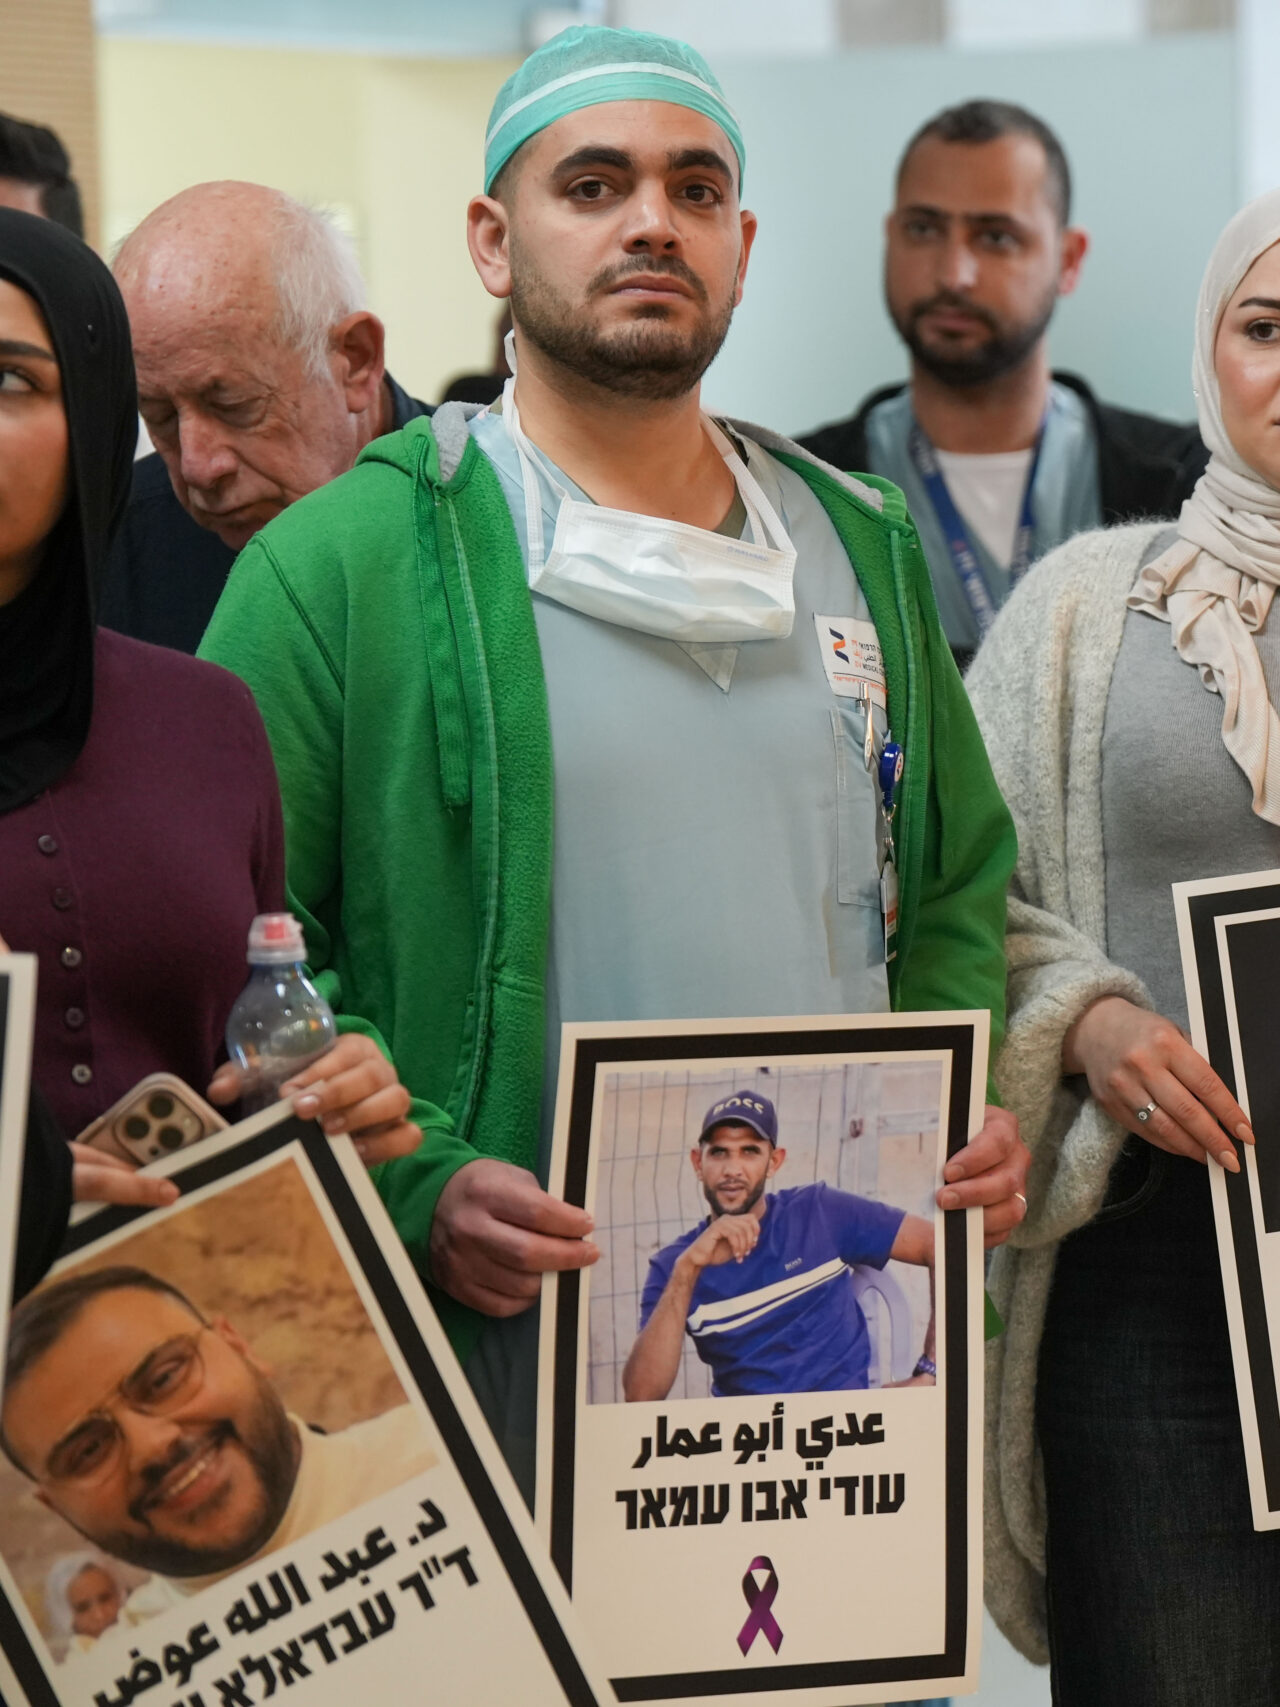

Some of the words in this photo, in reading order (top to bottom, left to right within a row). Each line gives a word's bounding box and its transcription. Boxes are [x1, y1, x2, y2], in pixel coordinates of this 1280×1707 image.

[631, 1415, 723, 1469] عمار
[732, 1401, 785, 1464] أبو
[795, 1412, 885, 1471] عدي
[615, 1483, 730, 1530] עמאר
[741, 1478, 808, 1523] אבו
[819, 1472, 905, 1517] עודי
[319, 1525, 397, 1593] عبد
[397, 1544, 479, 1611] ד"ר
[223, 1561, 312, 1636] الله
[92, 1621, 221, 1707] عوض
